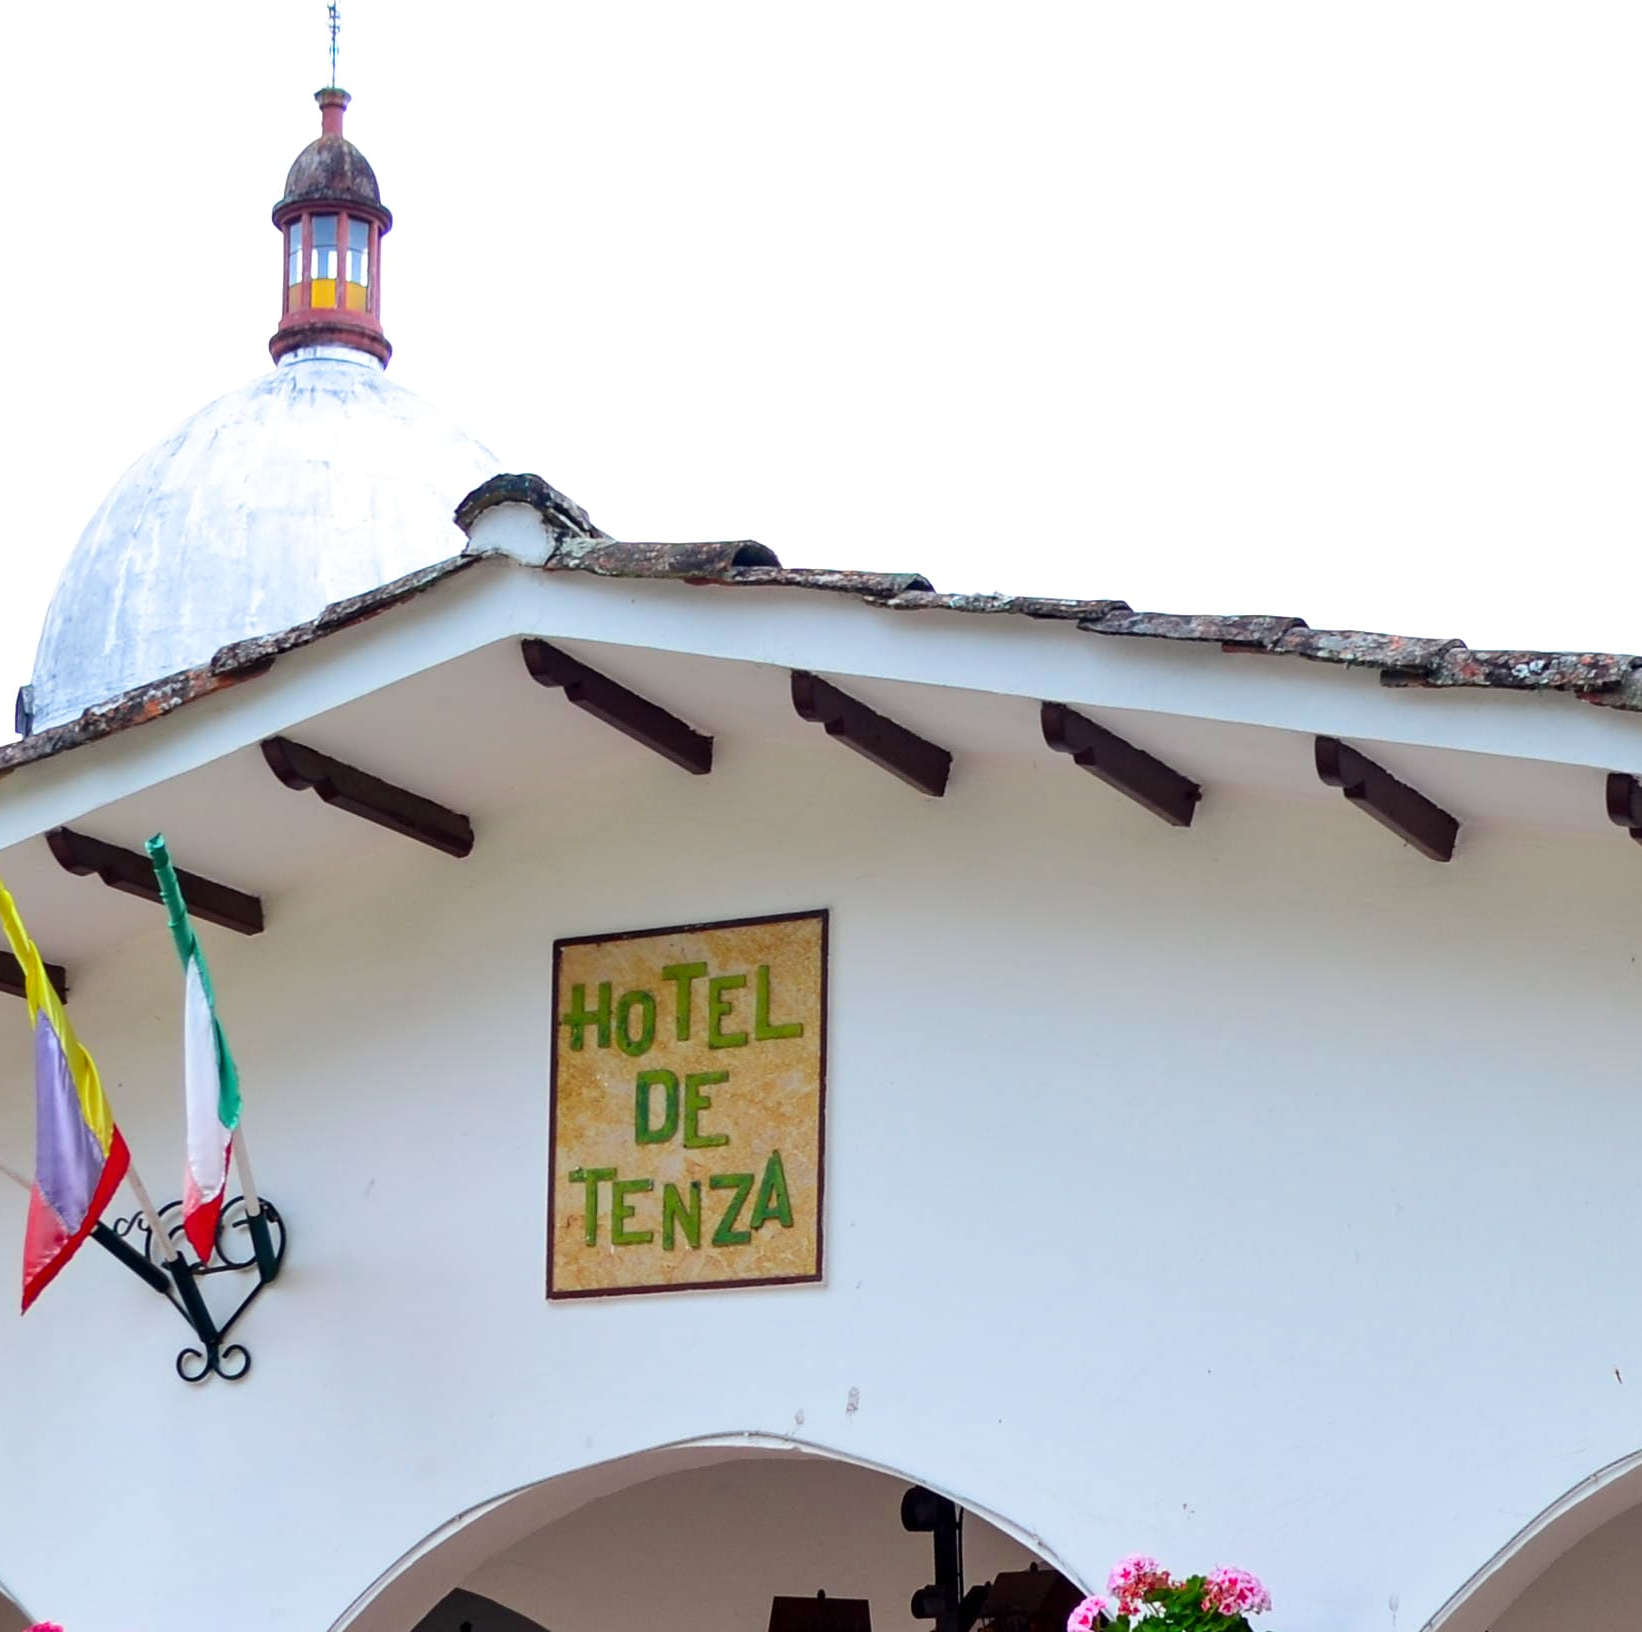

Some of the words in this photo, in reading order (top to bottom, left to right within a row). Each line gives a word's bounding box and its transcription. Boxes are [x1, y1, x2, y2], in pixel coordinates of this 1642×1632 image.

[561, 961, 804, 1057] HOTEL
[634, 1068, 730, 1150] DE
[568, 1149, 795, 1252] TENZA
